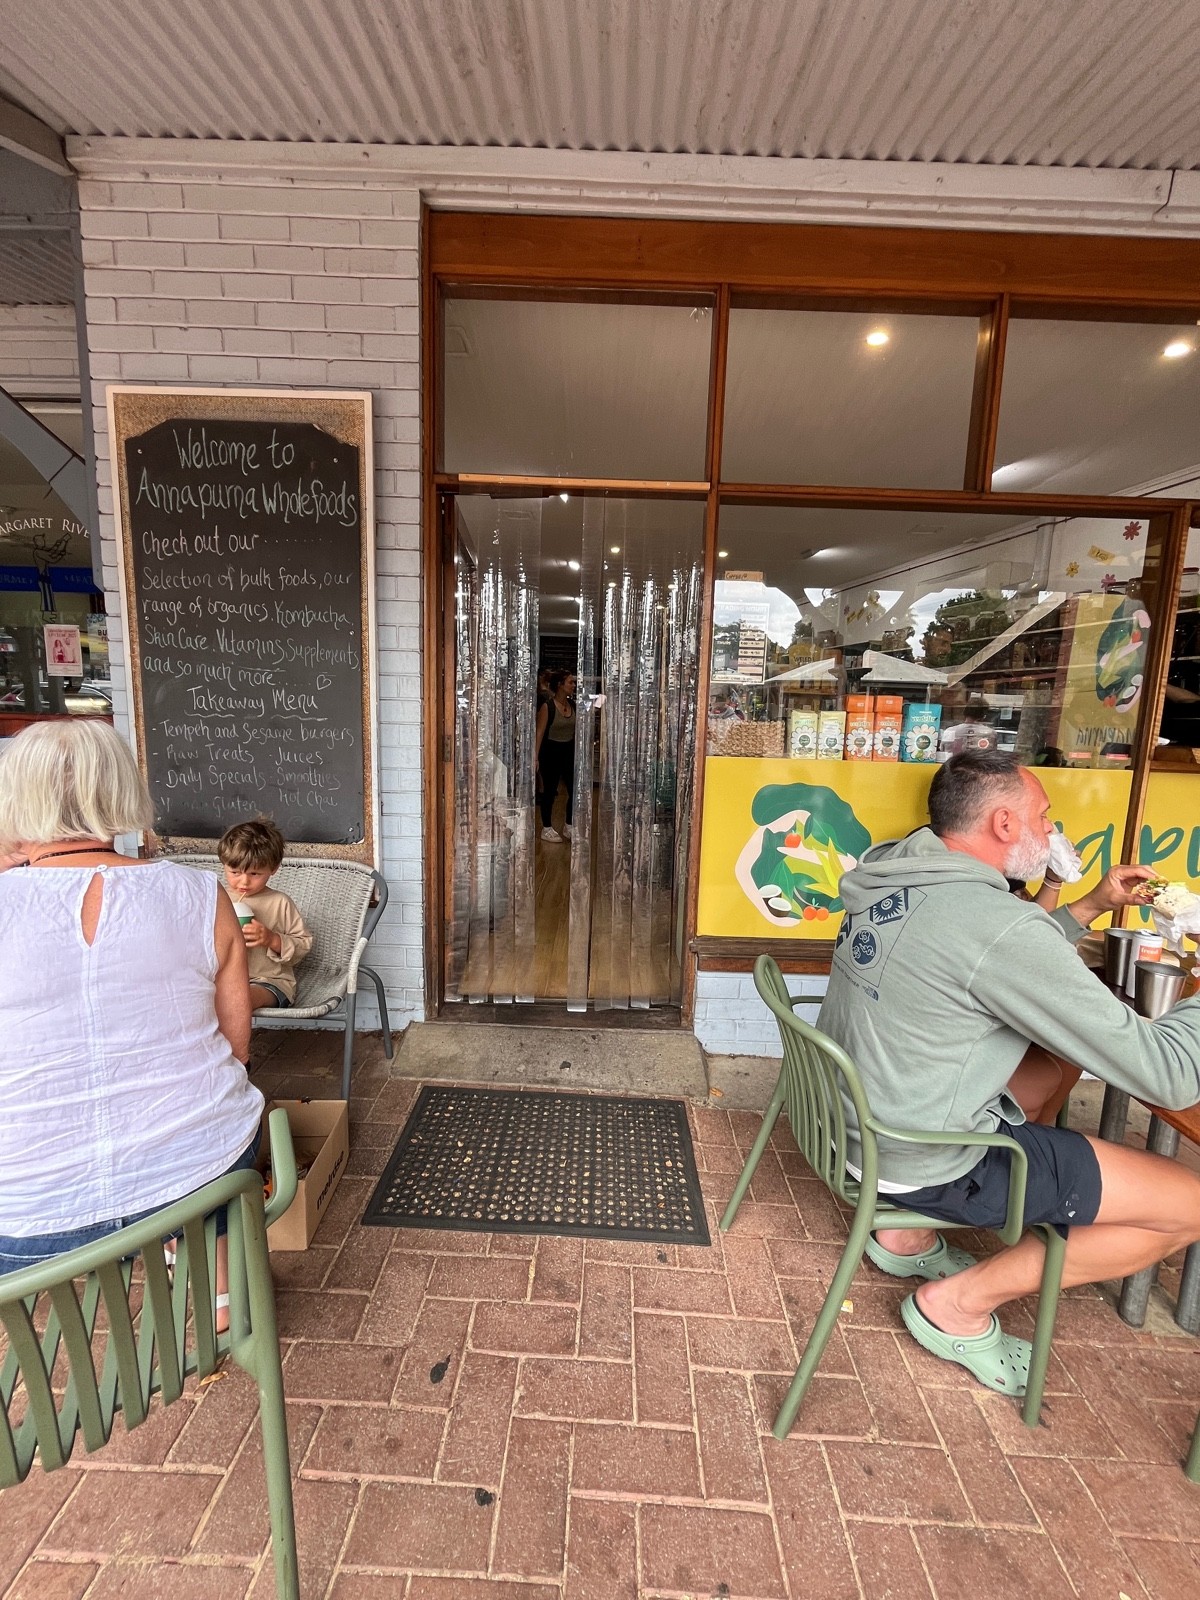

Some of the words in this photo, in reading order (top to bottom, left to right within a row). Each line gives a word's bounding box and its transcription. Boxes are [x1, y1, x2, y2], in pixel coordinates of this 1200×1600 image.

[173, 427, 260, 476] Welcome
[267, 428, 295, 469] to
[135, 467, 260, 520] Annapurna
[261, 478, 358, 527] Wholefoods
[142, 529, 192, 560] Check
[194, 525, 224, 556] out
[142, 566, 212, 590] Selection
[217, 563, 236, 590] of
[240, 567, 275, 591] bulk
[324, 572, 353, 587] our
[141, 598, 185, 626] range
[189, 595, 202, 618] of
[144, 655, 174, 674] and
[175, 660, 192, 678] so
[196, 662, 237, 691] much
[186, 685, 265, 718] Takeaway
[272, 688, 318, 714] Menu
[159, 718, 210, 738] Tempeh
[214, 725, 240, 739] and
[242, 722, 294, 745] Sesame
[301, 724, 355, 750] burgers
[167, 744, 199, 764] Raw
[205, 743, 255, 764] Treats
[275, 746, 324, 766] Juices
[165, 769, 202, 789] Daily
[209, 765, 267, 791] Specials
[277, 766, 341, 790] Smoothies
